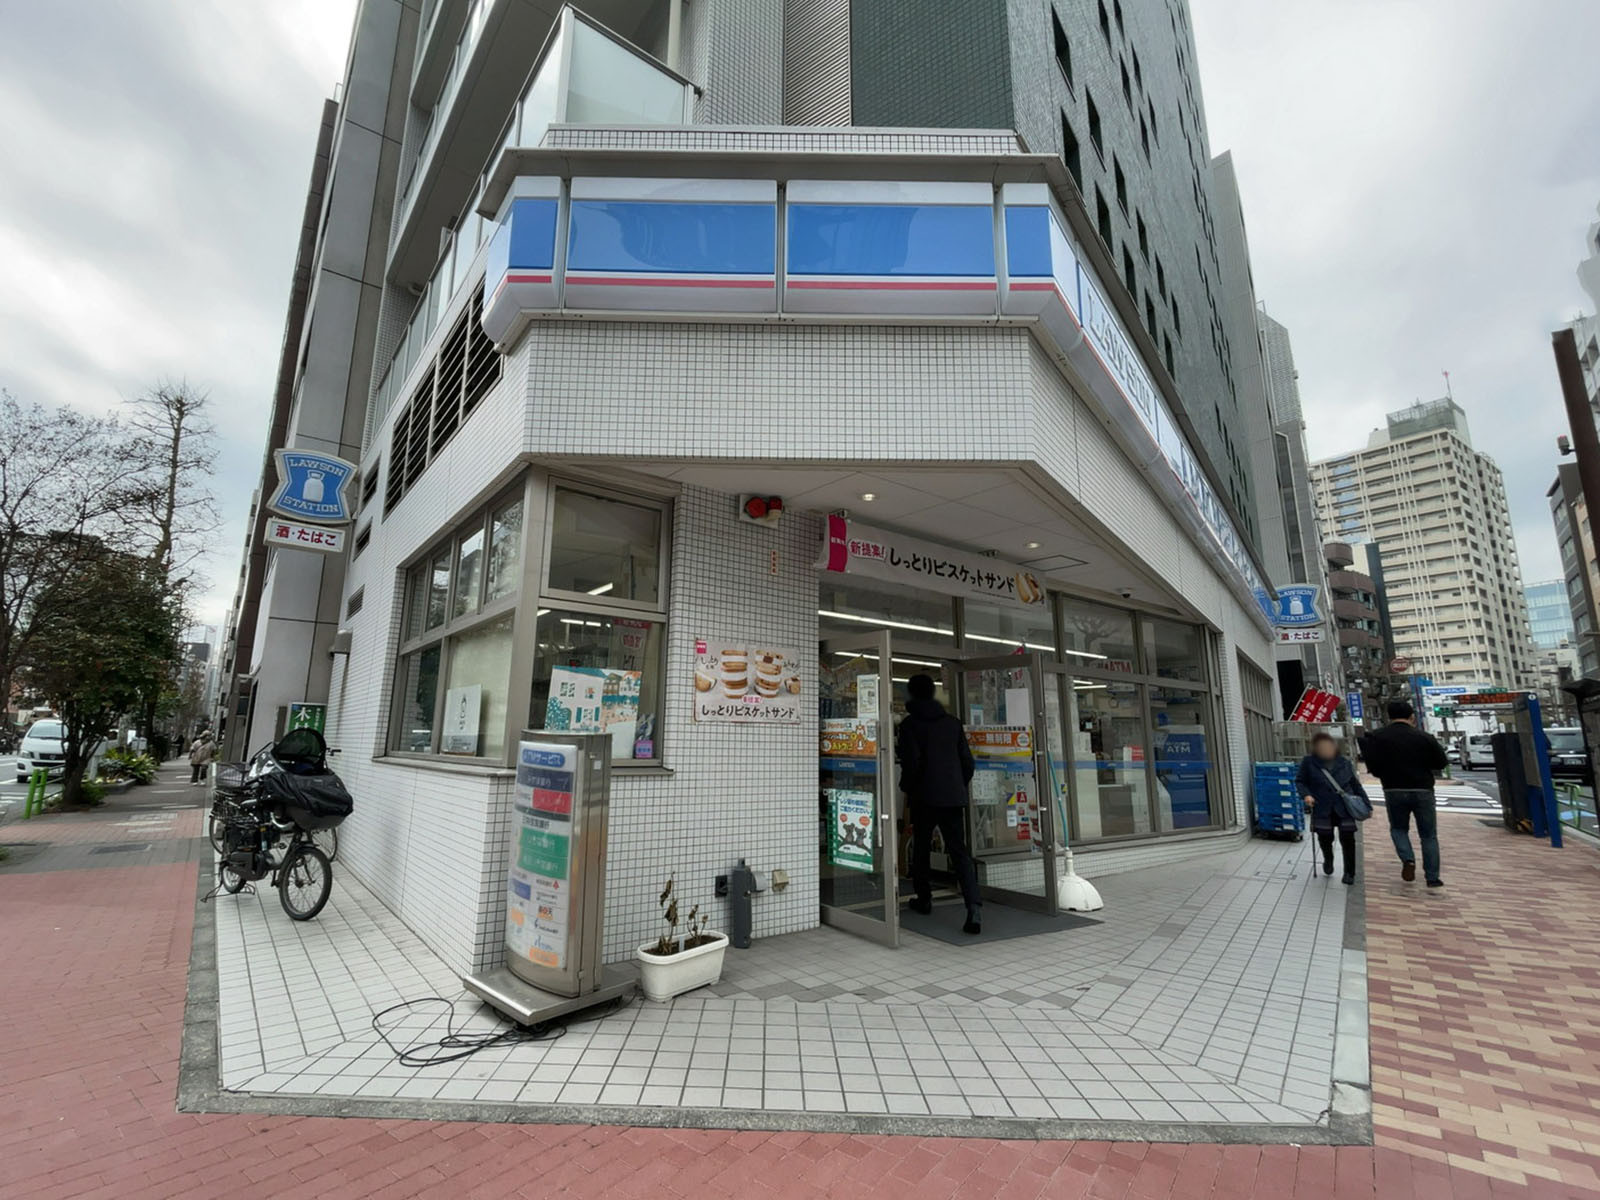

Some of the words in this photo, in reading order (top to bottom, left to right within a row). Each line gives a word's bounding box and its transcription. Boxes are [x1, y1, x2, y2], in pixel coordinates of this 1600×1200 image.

[1087, 286, 1153, 427] LAWSON
[289, 458, 344, 477] LAWSON
[283, 495, 339, 513] STATION
[275, 524, 336, 546] 酒・たばこ
[889, 546, 1016, 593] しっとりビスケットサンド
[1280, 612, 1316, 621] STATION
[1280, 631, 1320, 641] 酒・たばこ
[702, 704, 796, 719] しっとりビスケットサンド
[1166, 745, 1191, 753] ATM
